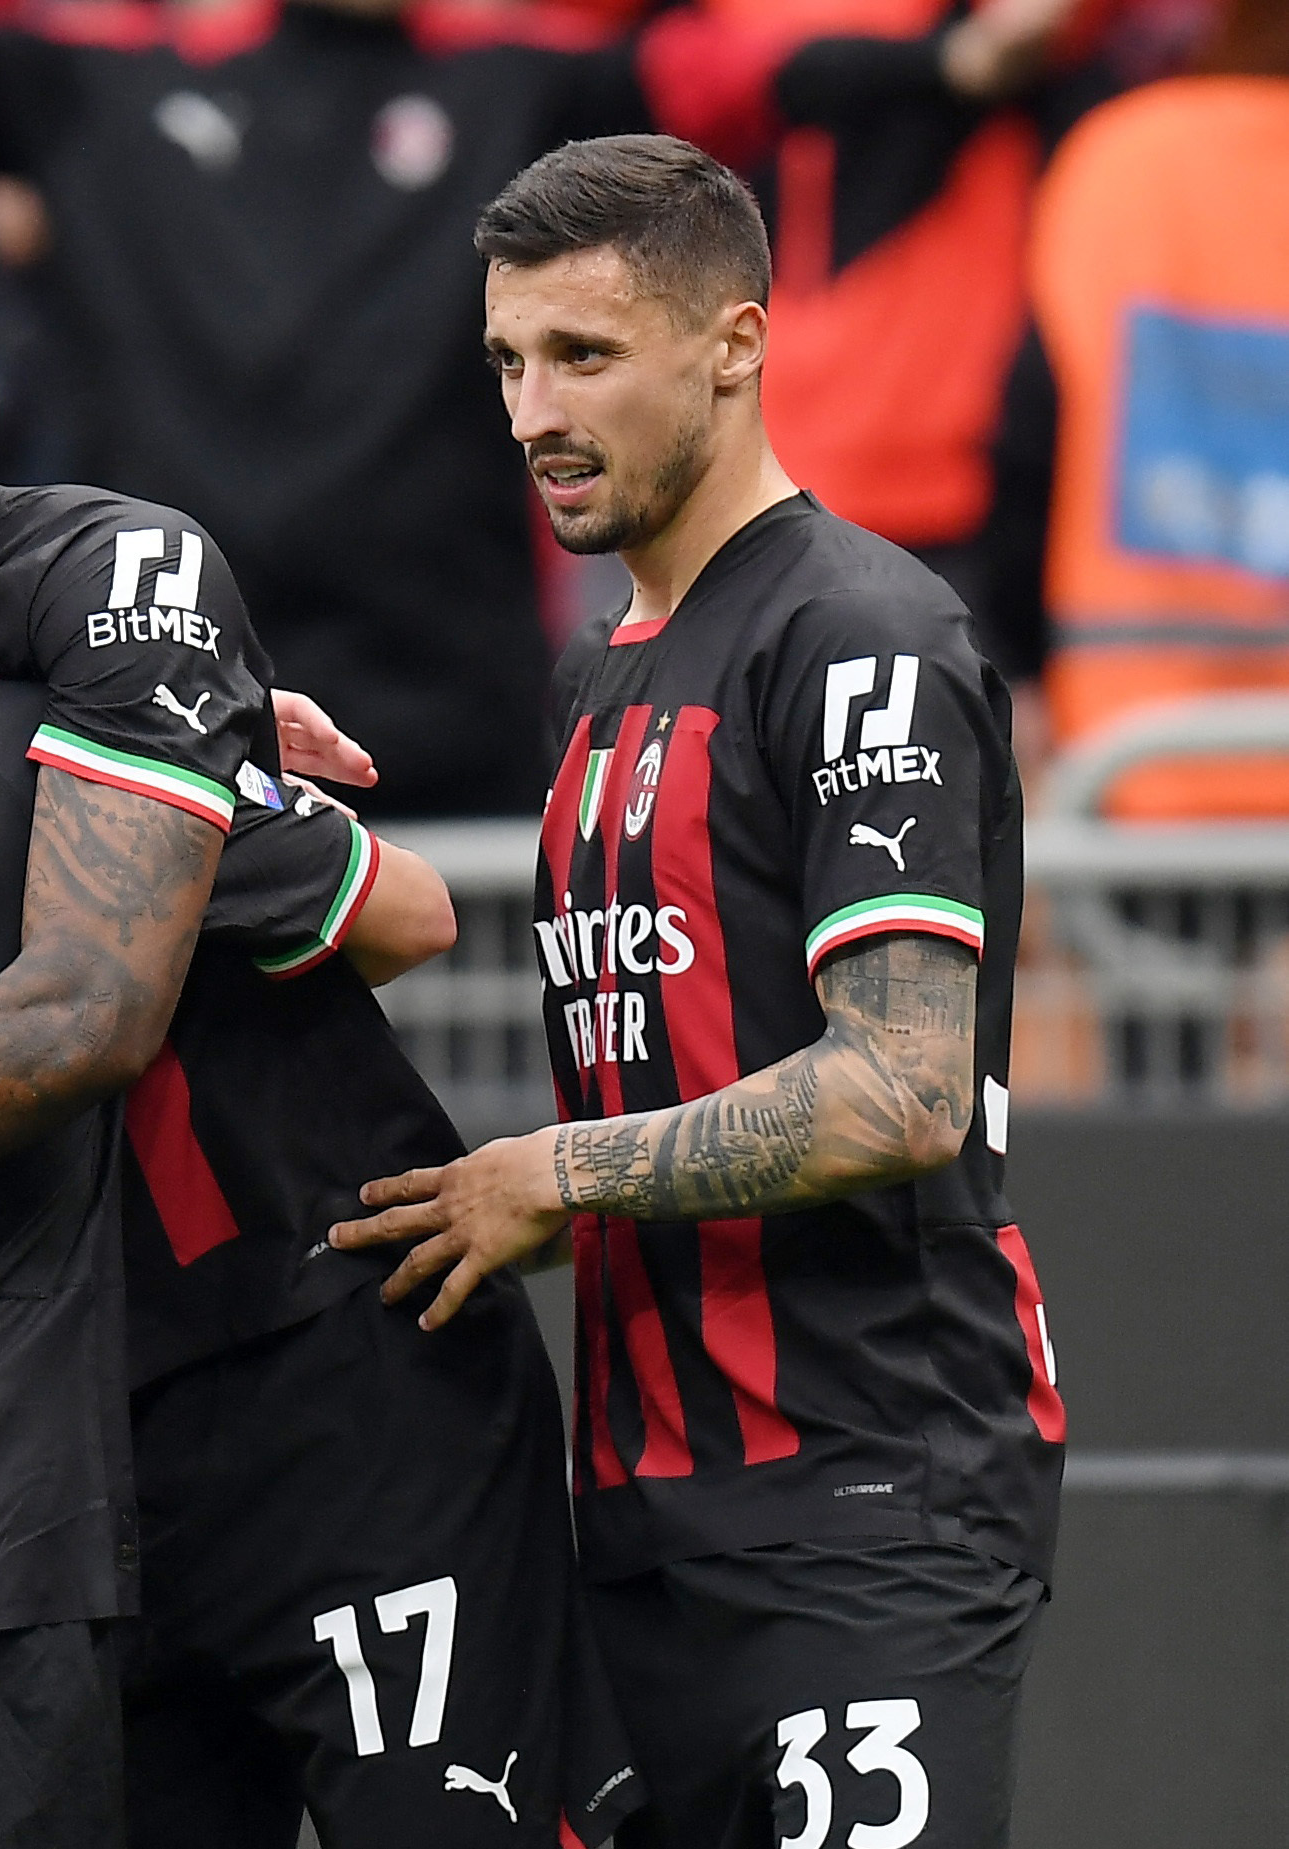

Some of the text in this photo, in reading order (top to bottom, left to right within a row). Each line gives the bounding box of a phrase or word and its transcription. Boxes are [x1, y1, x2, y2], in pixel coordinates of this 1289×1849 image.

[87, 607, 221, 660] BitMEX
[313, 1576, 457, 1756] 17
[776, 1698, 930, 1849] 33
